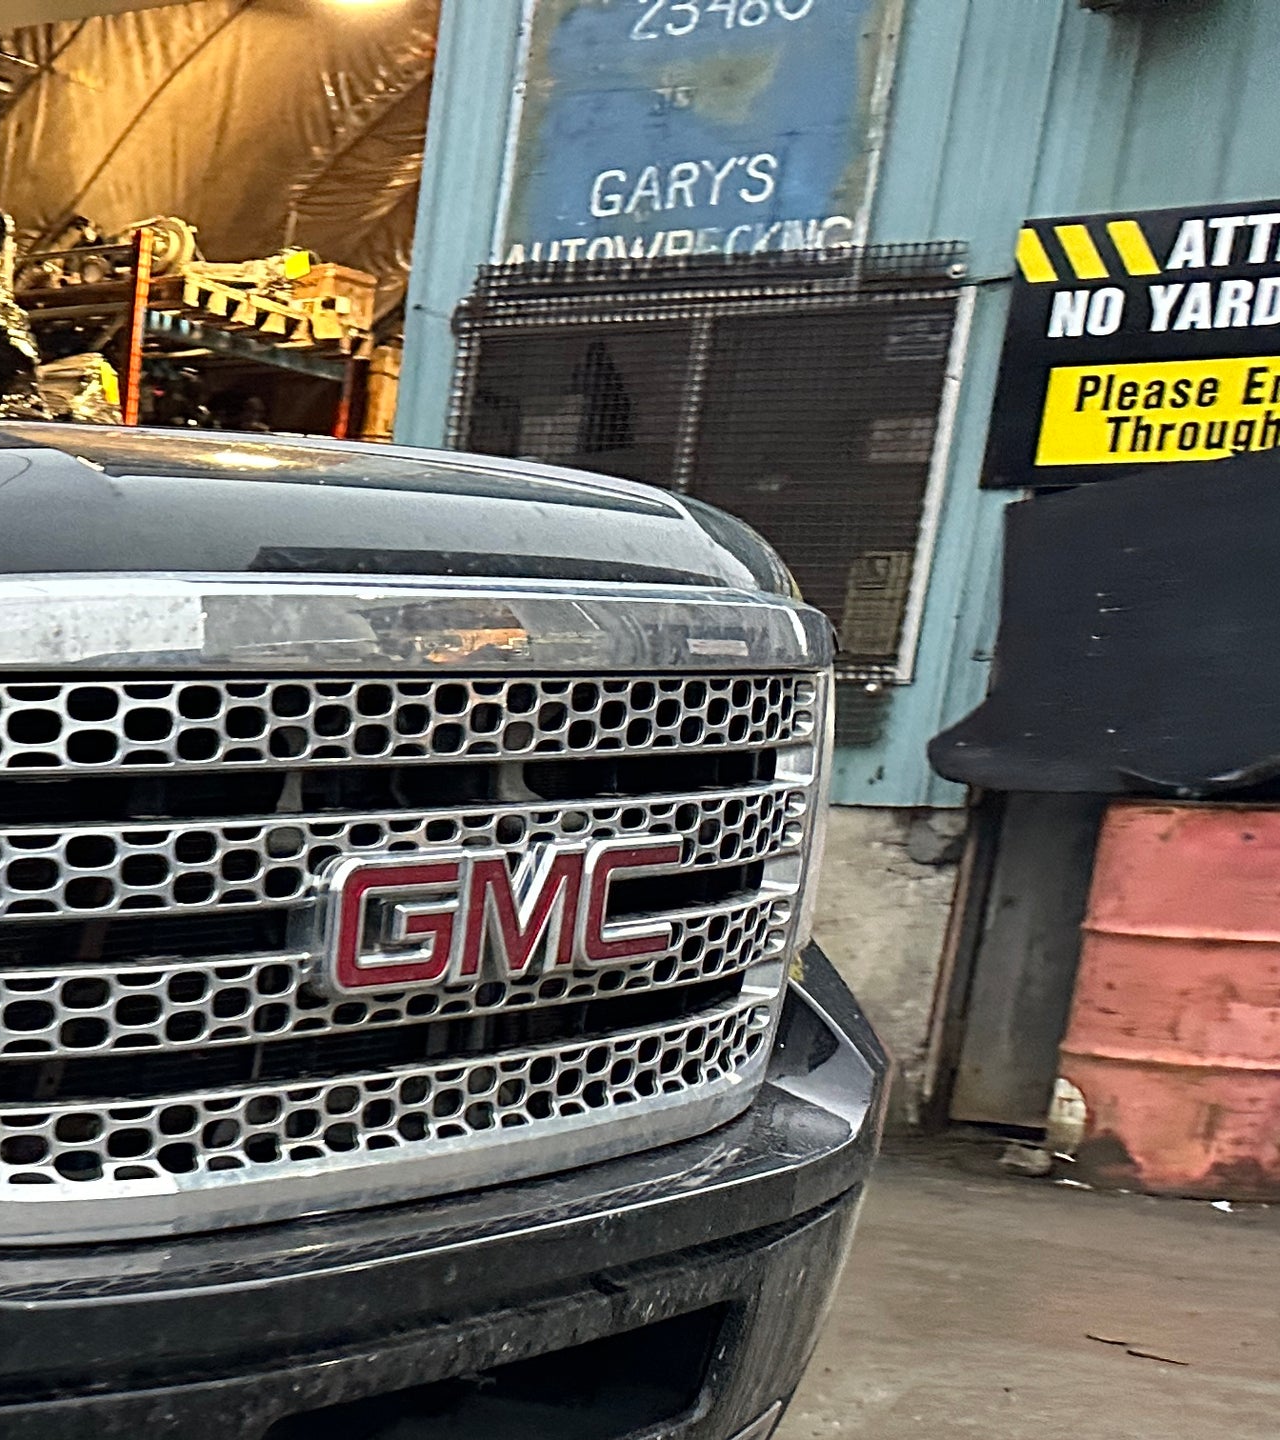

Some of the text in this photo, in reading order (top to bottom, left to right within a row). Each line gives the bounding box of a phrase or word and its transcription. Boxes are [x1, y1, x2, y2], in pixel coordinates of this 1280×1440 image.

[590, 153, 778, 218] GARY'S
[1166, 212, 1280, 270] ATT
[1047, 277, 1280, 338] NO YARD
[1074, 374, 1220, 413] Please
[1105, 410, 1280, 457] Through
[332, 834, 684, 994] GMC
